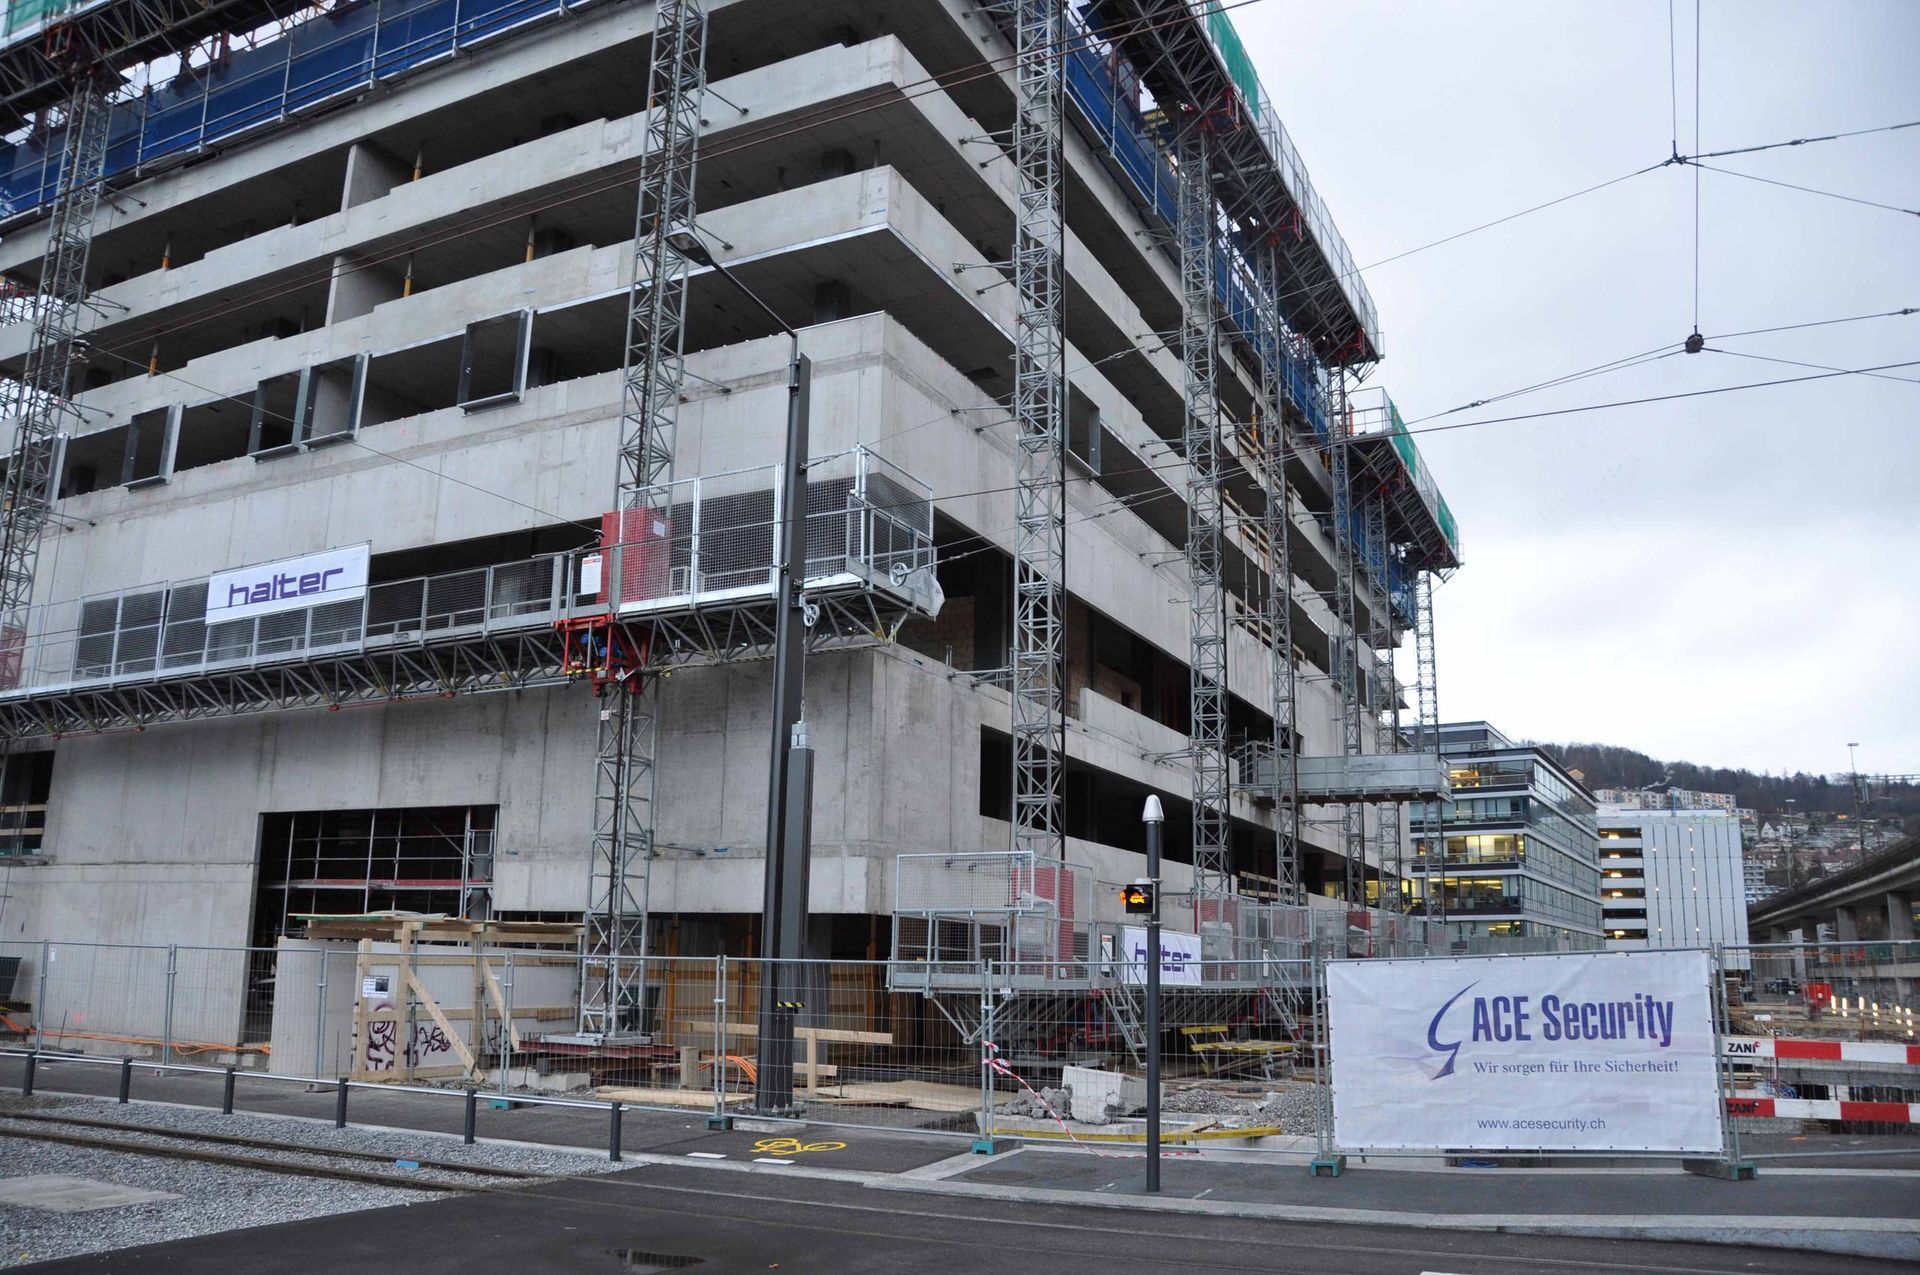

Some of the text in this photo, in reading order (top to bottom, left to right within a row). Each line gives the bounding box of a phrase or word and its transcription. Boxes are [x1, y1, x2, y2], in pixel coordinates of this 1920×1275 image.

[227, 567, 344, 608] halter
[1134, 942, 1191, 972] hter
[1472, 993, 1674, 1048] ACE Security
[1727, 1042, 1758, 1054] ZANI
[1474, 1059, 1679, 1076] Wir sorgen für Ihre Sicherheit!
[1477, 1118, 1606, 1132] www.acesecurity.ch
